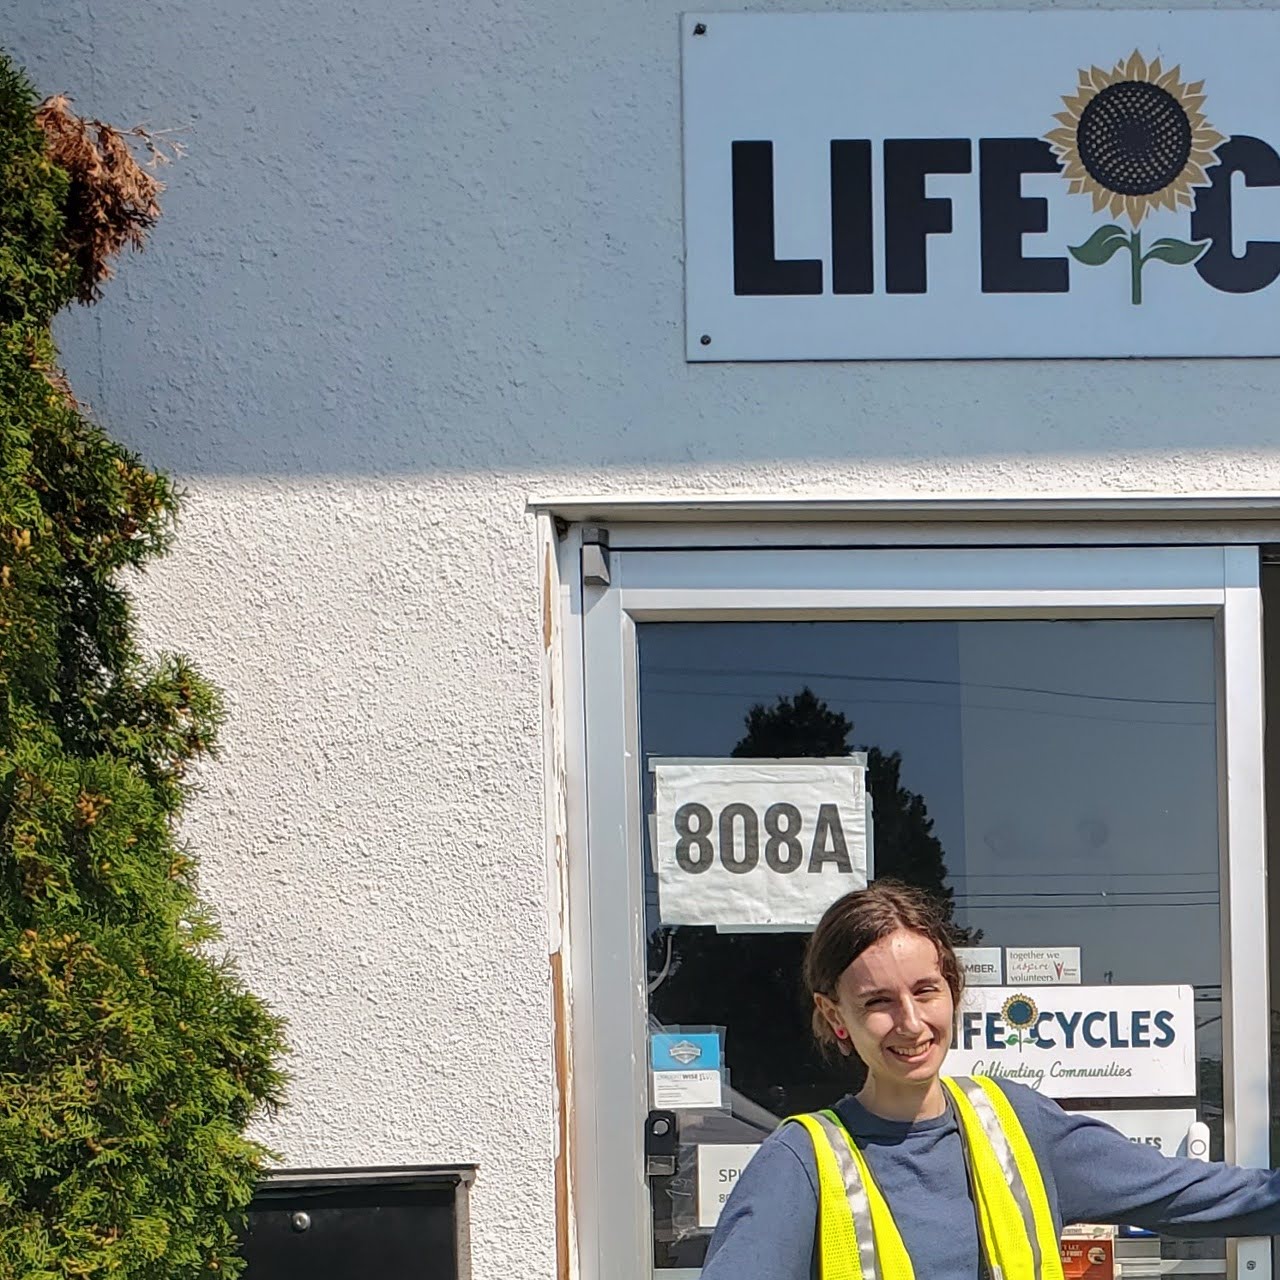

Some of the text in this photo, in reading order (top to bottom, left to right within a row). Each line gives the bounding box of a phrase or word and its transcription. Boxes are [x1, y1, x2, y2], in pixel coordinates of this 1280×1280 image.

[675, 802, 854, 875] 808A
[1010, 950, 1044, 961] together
[1012, 962, 1048, 972] inspire
[1010, 973, 1053, 982] volunteers
[971, 1060, 1133, 1089] Cultivating Communities
